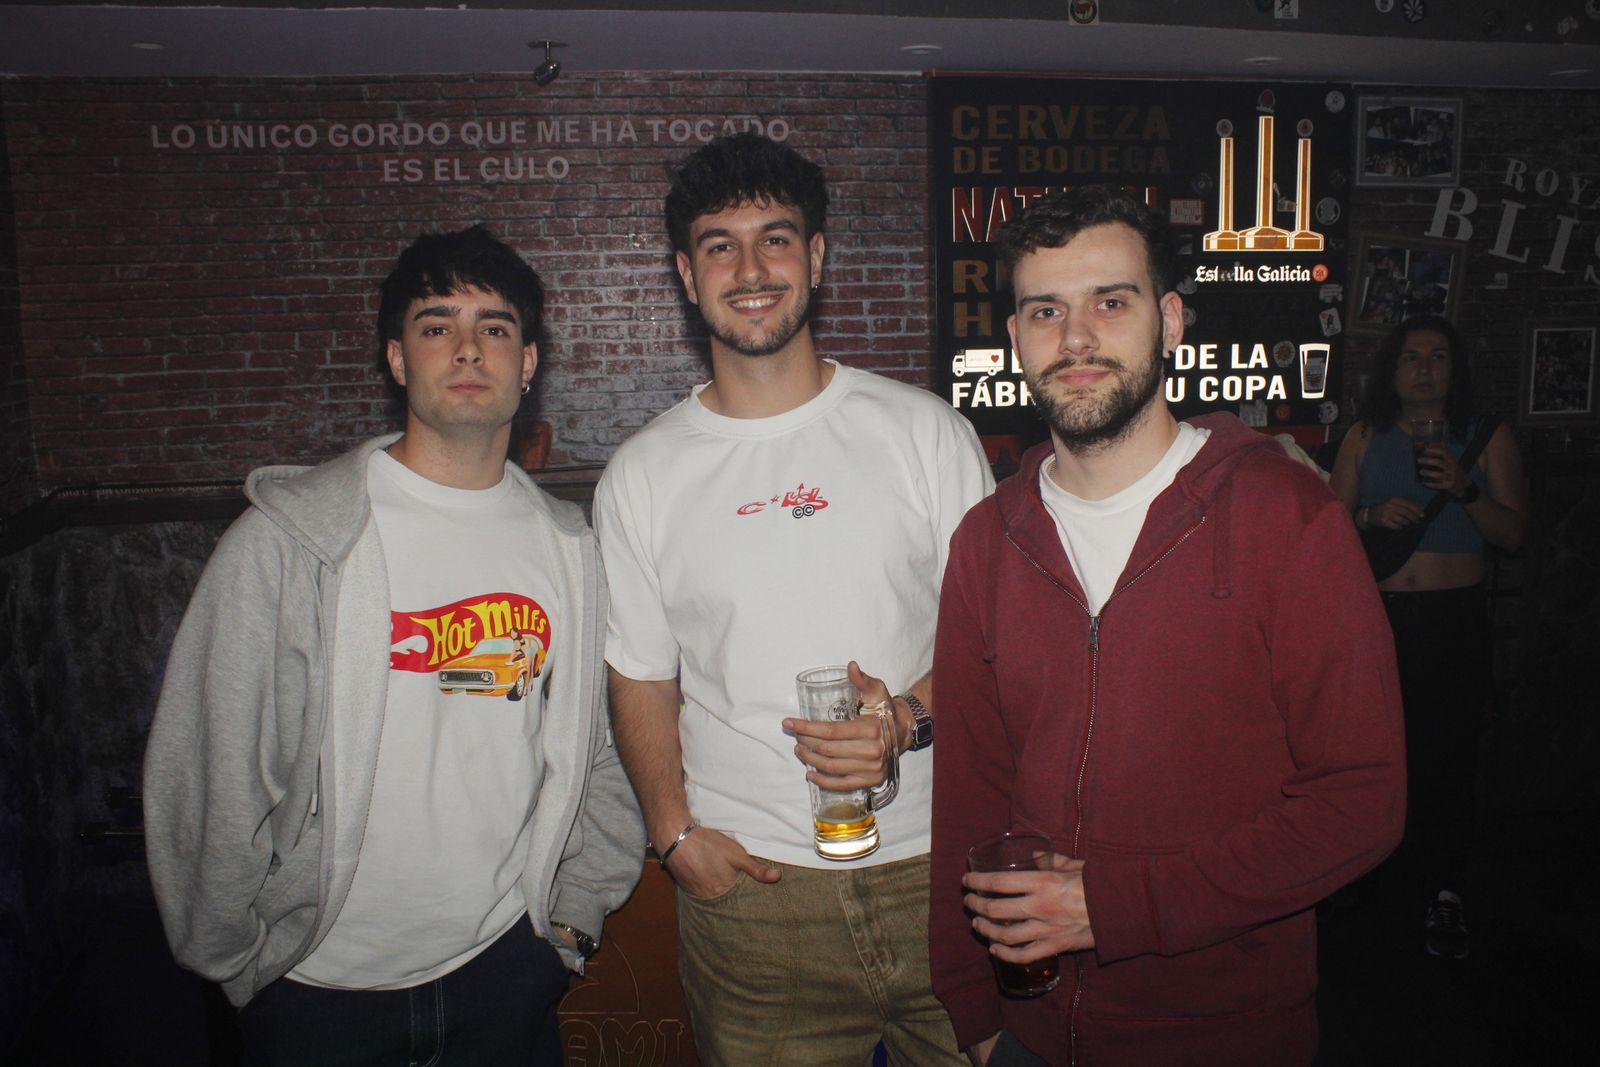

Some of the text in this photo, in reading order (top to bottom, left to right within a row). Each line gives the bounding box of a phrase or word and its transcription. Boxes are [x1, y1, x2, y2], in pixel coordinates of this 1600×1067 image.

[151, 118, 790, 150] LO ÚNICO GORDO QUE ME HA TOCADO
[951, 104, 1171, 141] CERVEZA
[382, 155, 571, 183] ES EL CULO
[953, 145, 1170, 174] DE BODEGA
[1257, 264, 1311, 283] Galicia
[1175, 343, 1269, 371] DE LA
[1165, 376, 1187, 403] U
[1199, 374, 1287, 402] COPA
[409, 600, 547, 665] Hot Milfs
